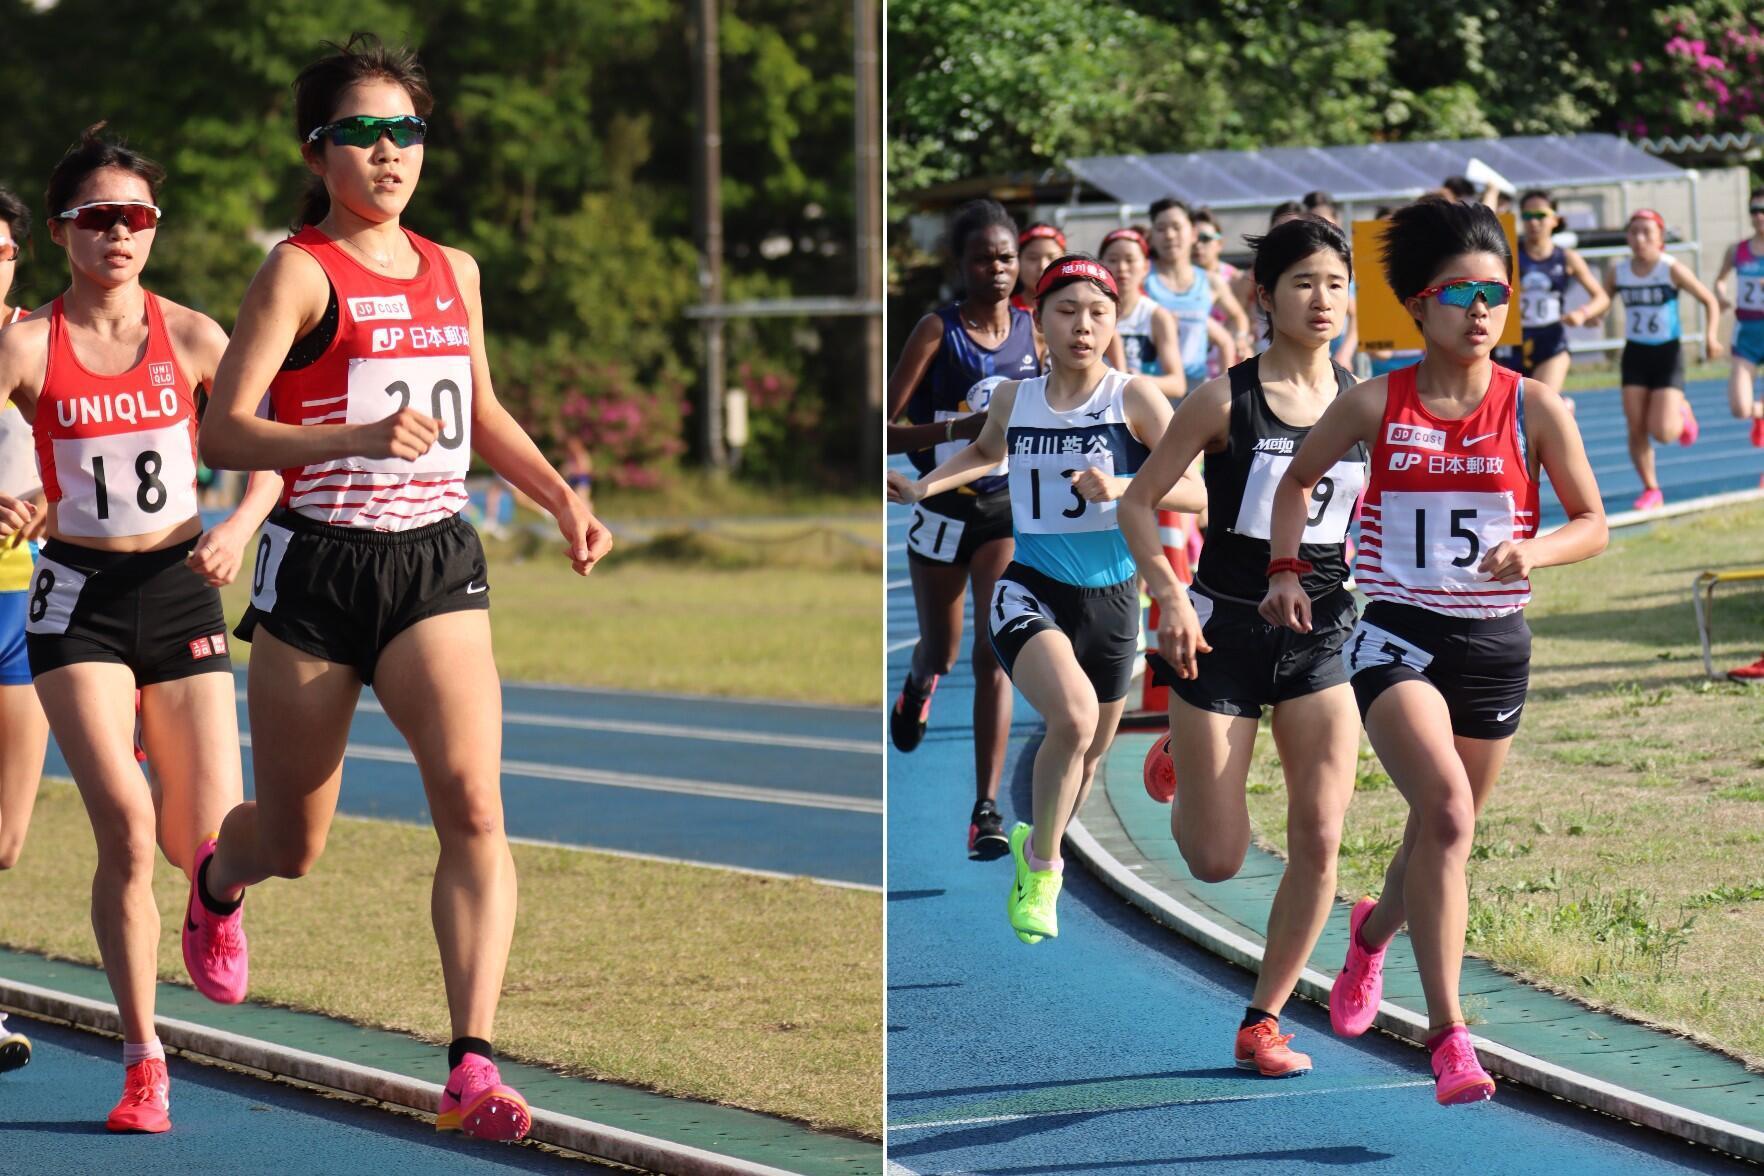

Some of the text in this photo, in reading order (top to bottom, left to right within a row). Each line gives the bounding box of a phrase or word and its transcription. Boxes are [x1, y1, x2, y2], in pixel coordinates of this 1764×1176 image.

[372, 327, 404, 352] JP
[1632, 311, 1660, 334] 26
[57, 388, 178, 428] UNIQLO
[1252, 437, 1295, 454] Meijo
[1388, 452, 1505, 475] JP 日本郵政
[92, 450, 167, 520] 18
[1030, 468, 1088, 520] 13
[909, 510, 948, 554] 21
[1415, 508, 1480, 568] 15
[29, 568, 56, 623] 8
